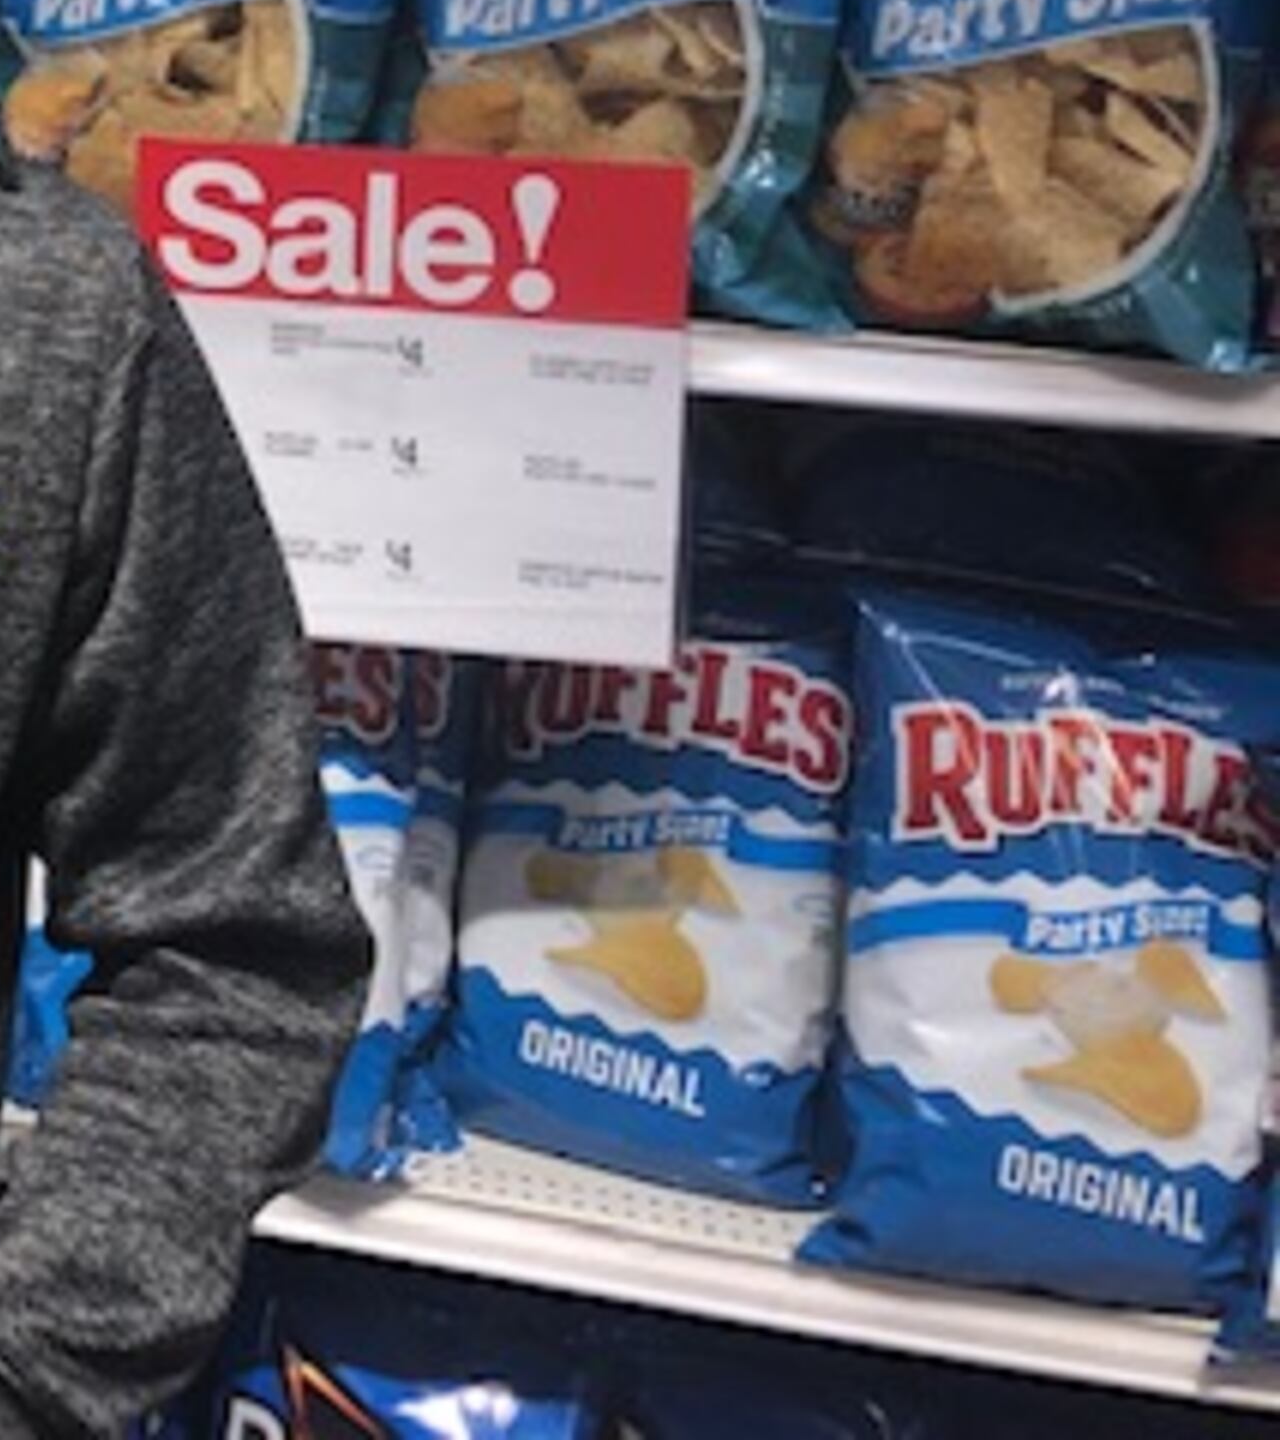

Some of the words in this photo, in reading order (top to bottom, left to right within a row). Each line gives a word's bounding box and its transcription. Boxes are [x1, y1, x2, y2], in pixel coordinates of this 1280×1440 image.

[157, 159, 561, 312] Sale!
[518, 1019, 707, 1117] ORIGINAL
[997, 1143, 1206, 1242] ORIGINAL
